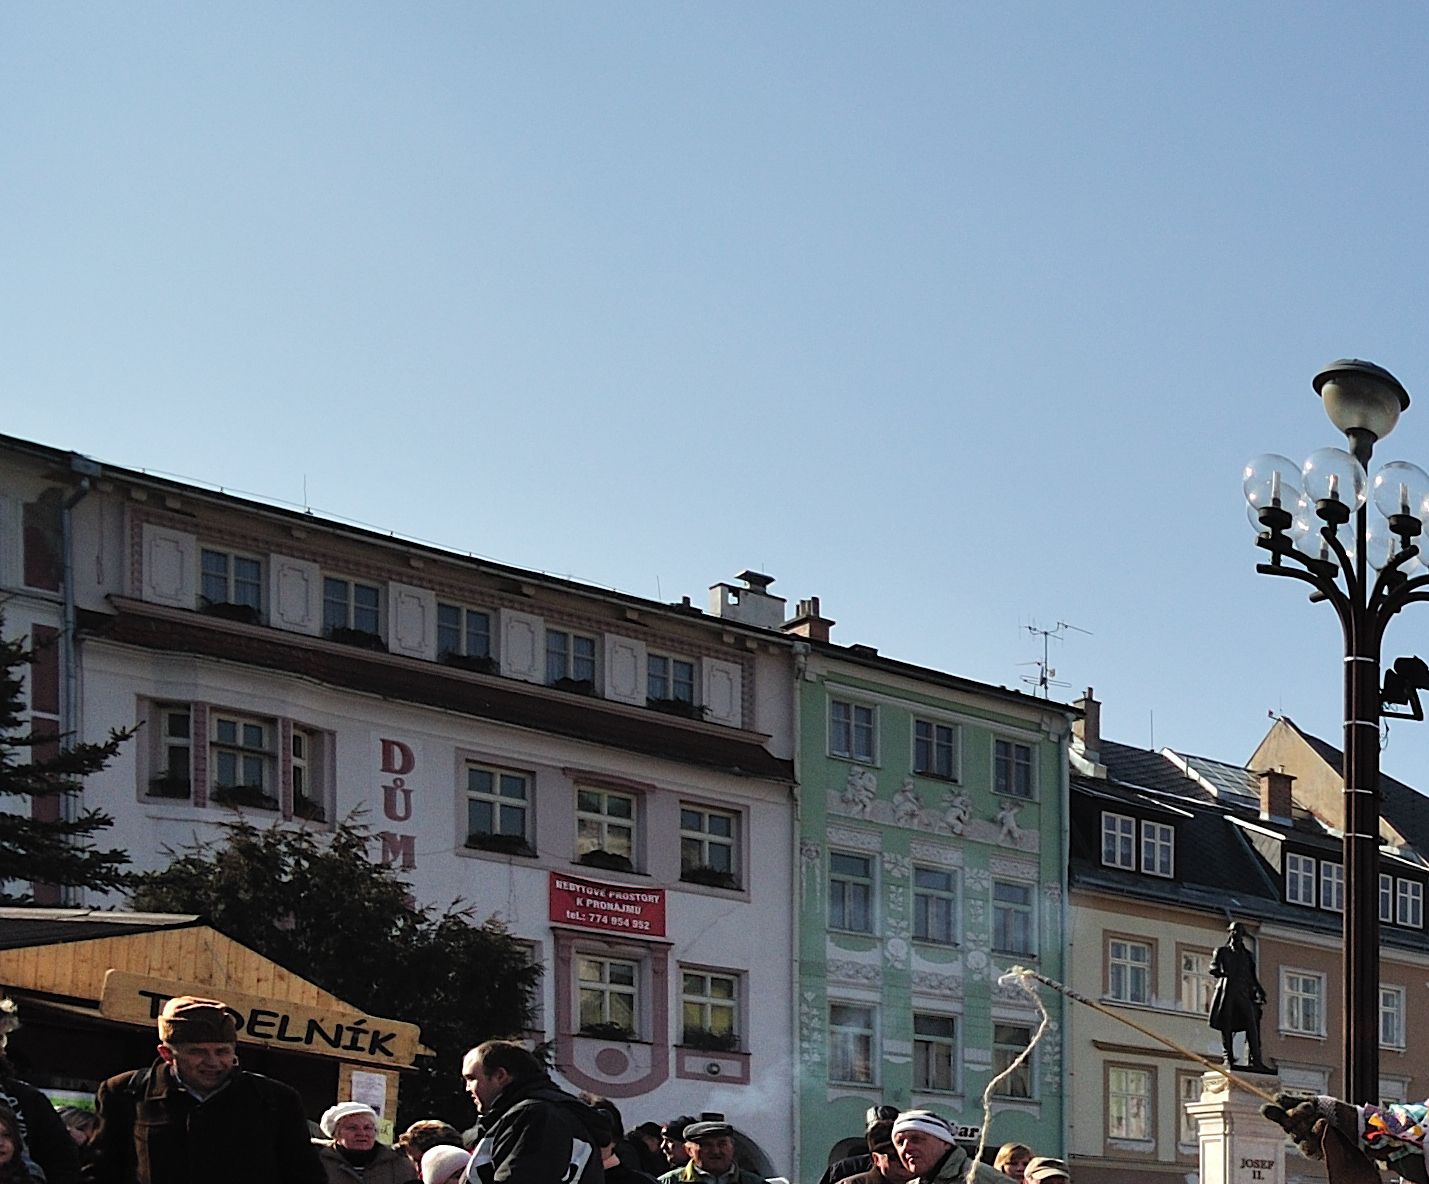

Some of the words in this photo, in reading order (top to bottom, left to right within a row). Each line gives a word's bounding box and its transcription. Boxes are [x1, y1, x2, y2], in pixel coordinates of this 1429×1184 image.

[379, 738, 417, 870] DŮM
[576, 897, 583, 907] K
[588, 913, 608, 924] 774
[138, 989, 398, 1058] TDELNÍK
[1240, 1158, 1275, 1169] JOSEF
